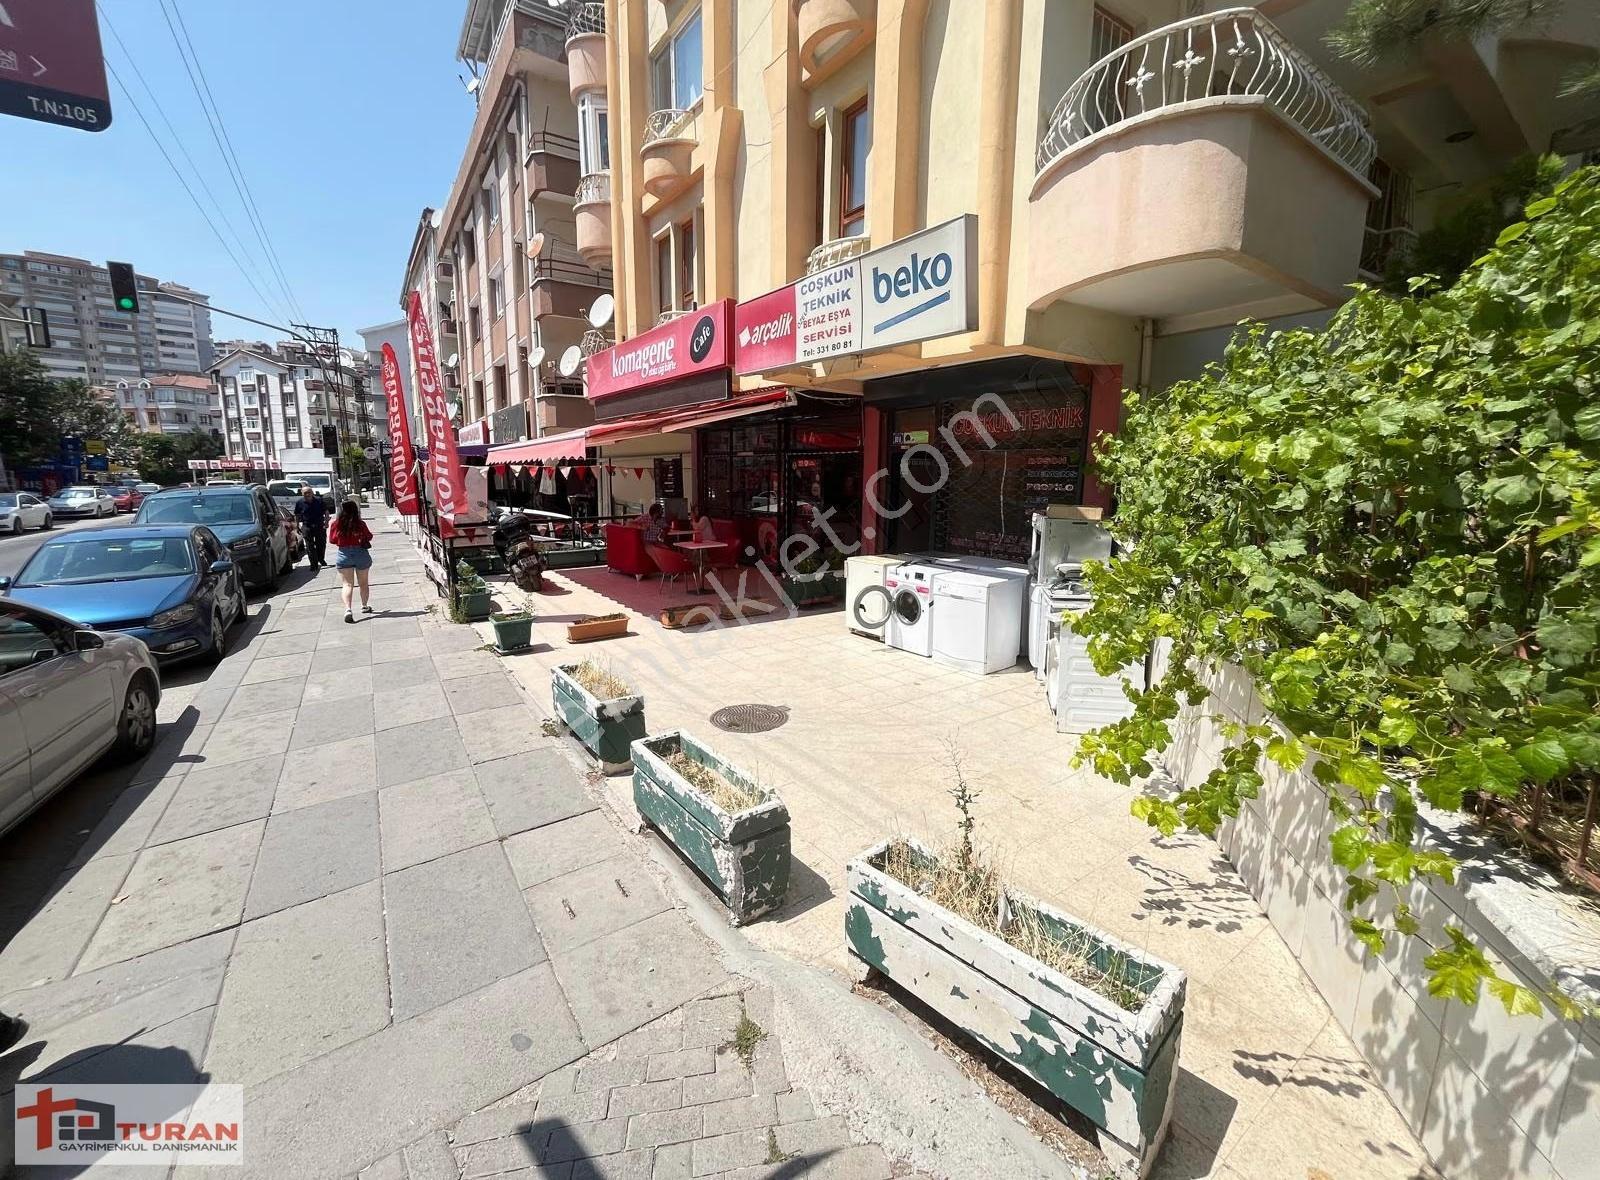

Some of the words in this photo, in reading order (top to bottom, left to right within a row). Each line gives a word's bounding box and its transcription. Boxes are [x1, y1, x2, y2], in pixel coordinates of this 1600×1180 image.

[27, 95, 98, 124] T.N:105
[800, 264, 854, 296] COŞKUN
[872, 250, 954, 305] beko
[803, 287, 852, 313] TEKNİK
[752, 311, 794, 346] arçelik
[802, 316, 826, 329] BEYAZ
[828, 308, 851, 322] EŞYA
[692, 325, 712, 353] Cafe
[803, 323, 852, 344] SERVİSİ
[611, 336, 675, 379] komagene
[803, 348, 815, 357] Tel:
[817, 345, 830, 356] 331
[832, 342, 841, 352] 80
[844, 340, 853, 350] 81
[1019, 402, 1084, 431] TEKNİK
